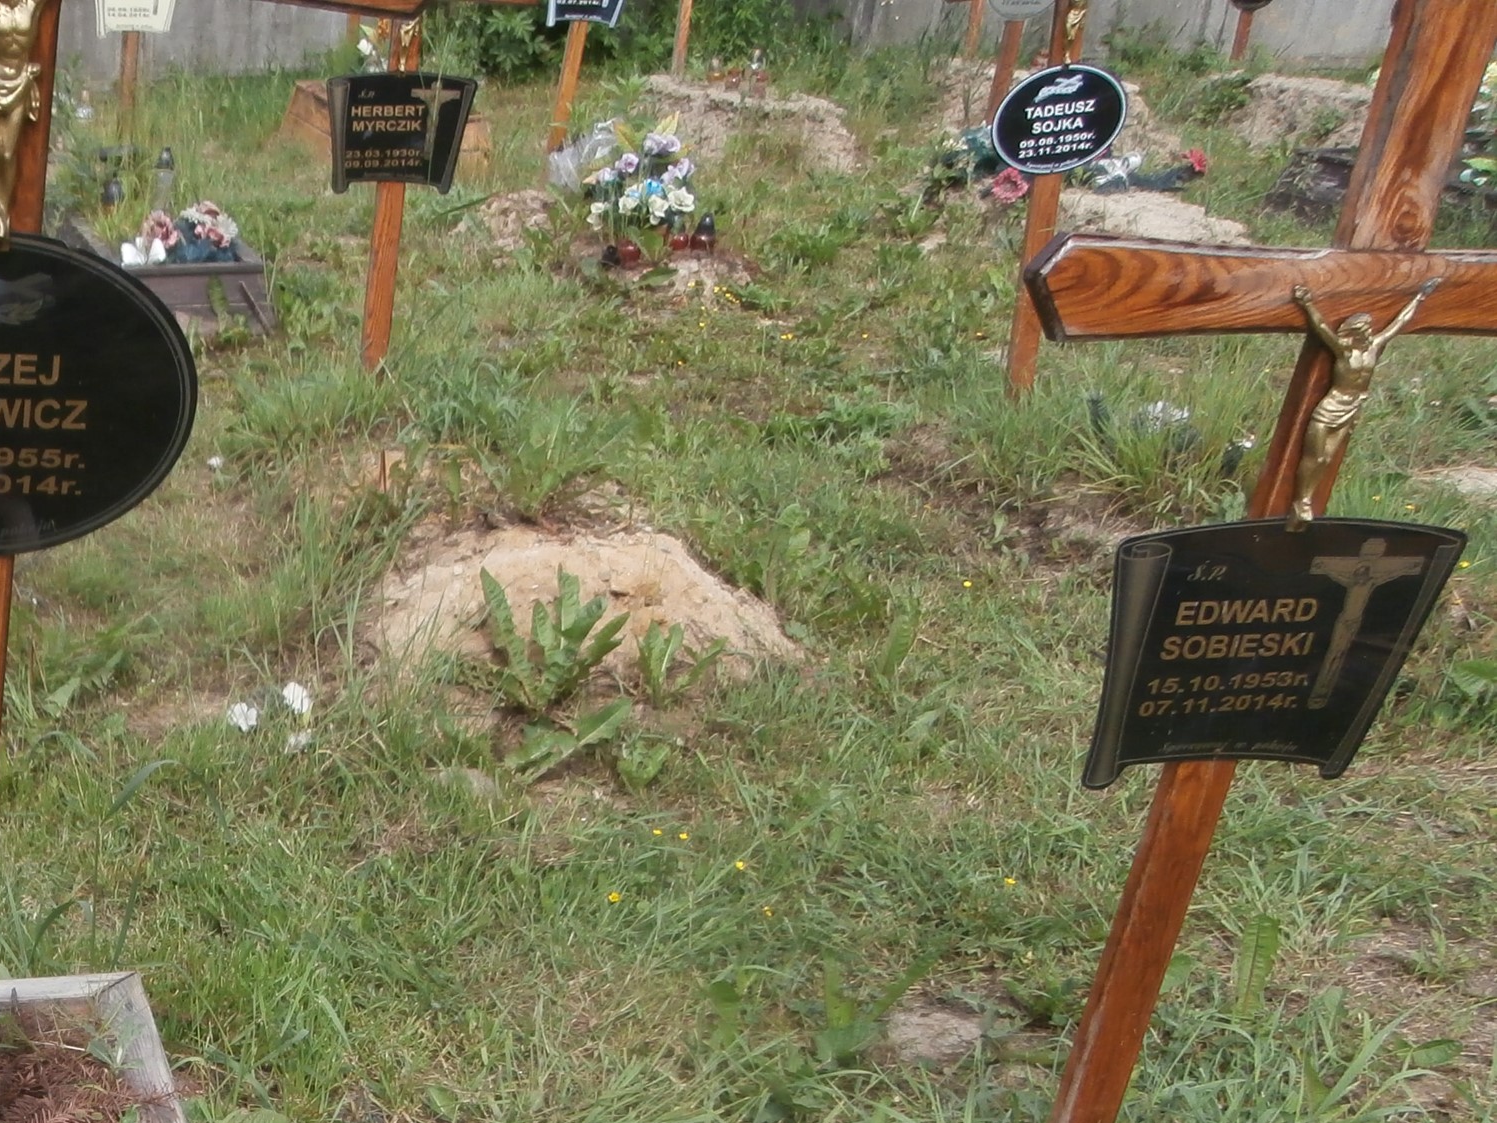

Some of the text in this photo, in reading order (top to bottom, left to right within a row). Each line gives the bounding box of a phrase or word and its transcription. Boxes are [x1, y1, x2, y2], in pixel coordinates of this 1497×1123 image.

[350, 105, 426, 118] HERBERT
[1024, 99, 1096, 119] TADEUSZ
[352, 120, 423, 132] MYRCZIK
[1031, 116, 1084, 135] SOJKA
[1019, 131, 1097, 149] 09.08.1950r.
[1018, 142, 1094, 159] 23.11.2014r.
[1187, 560, 1226, 582] Ś.P.
[1174, 598, 1319, 627] EDWARD
[1159, 632, 1314, 661] SOBIESKI
[1147, 671, 1309, 695] 15.10.1953r.
[1139, 693, 1298, 717] 07.11.2014r.
